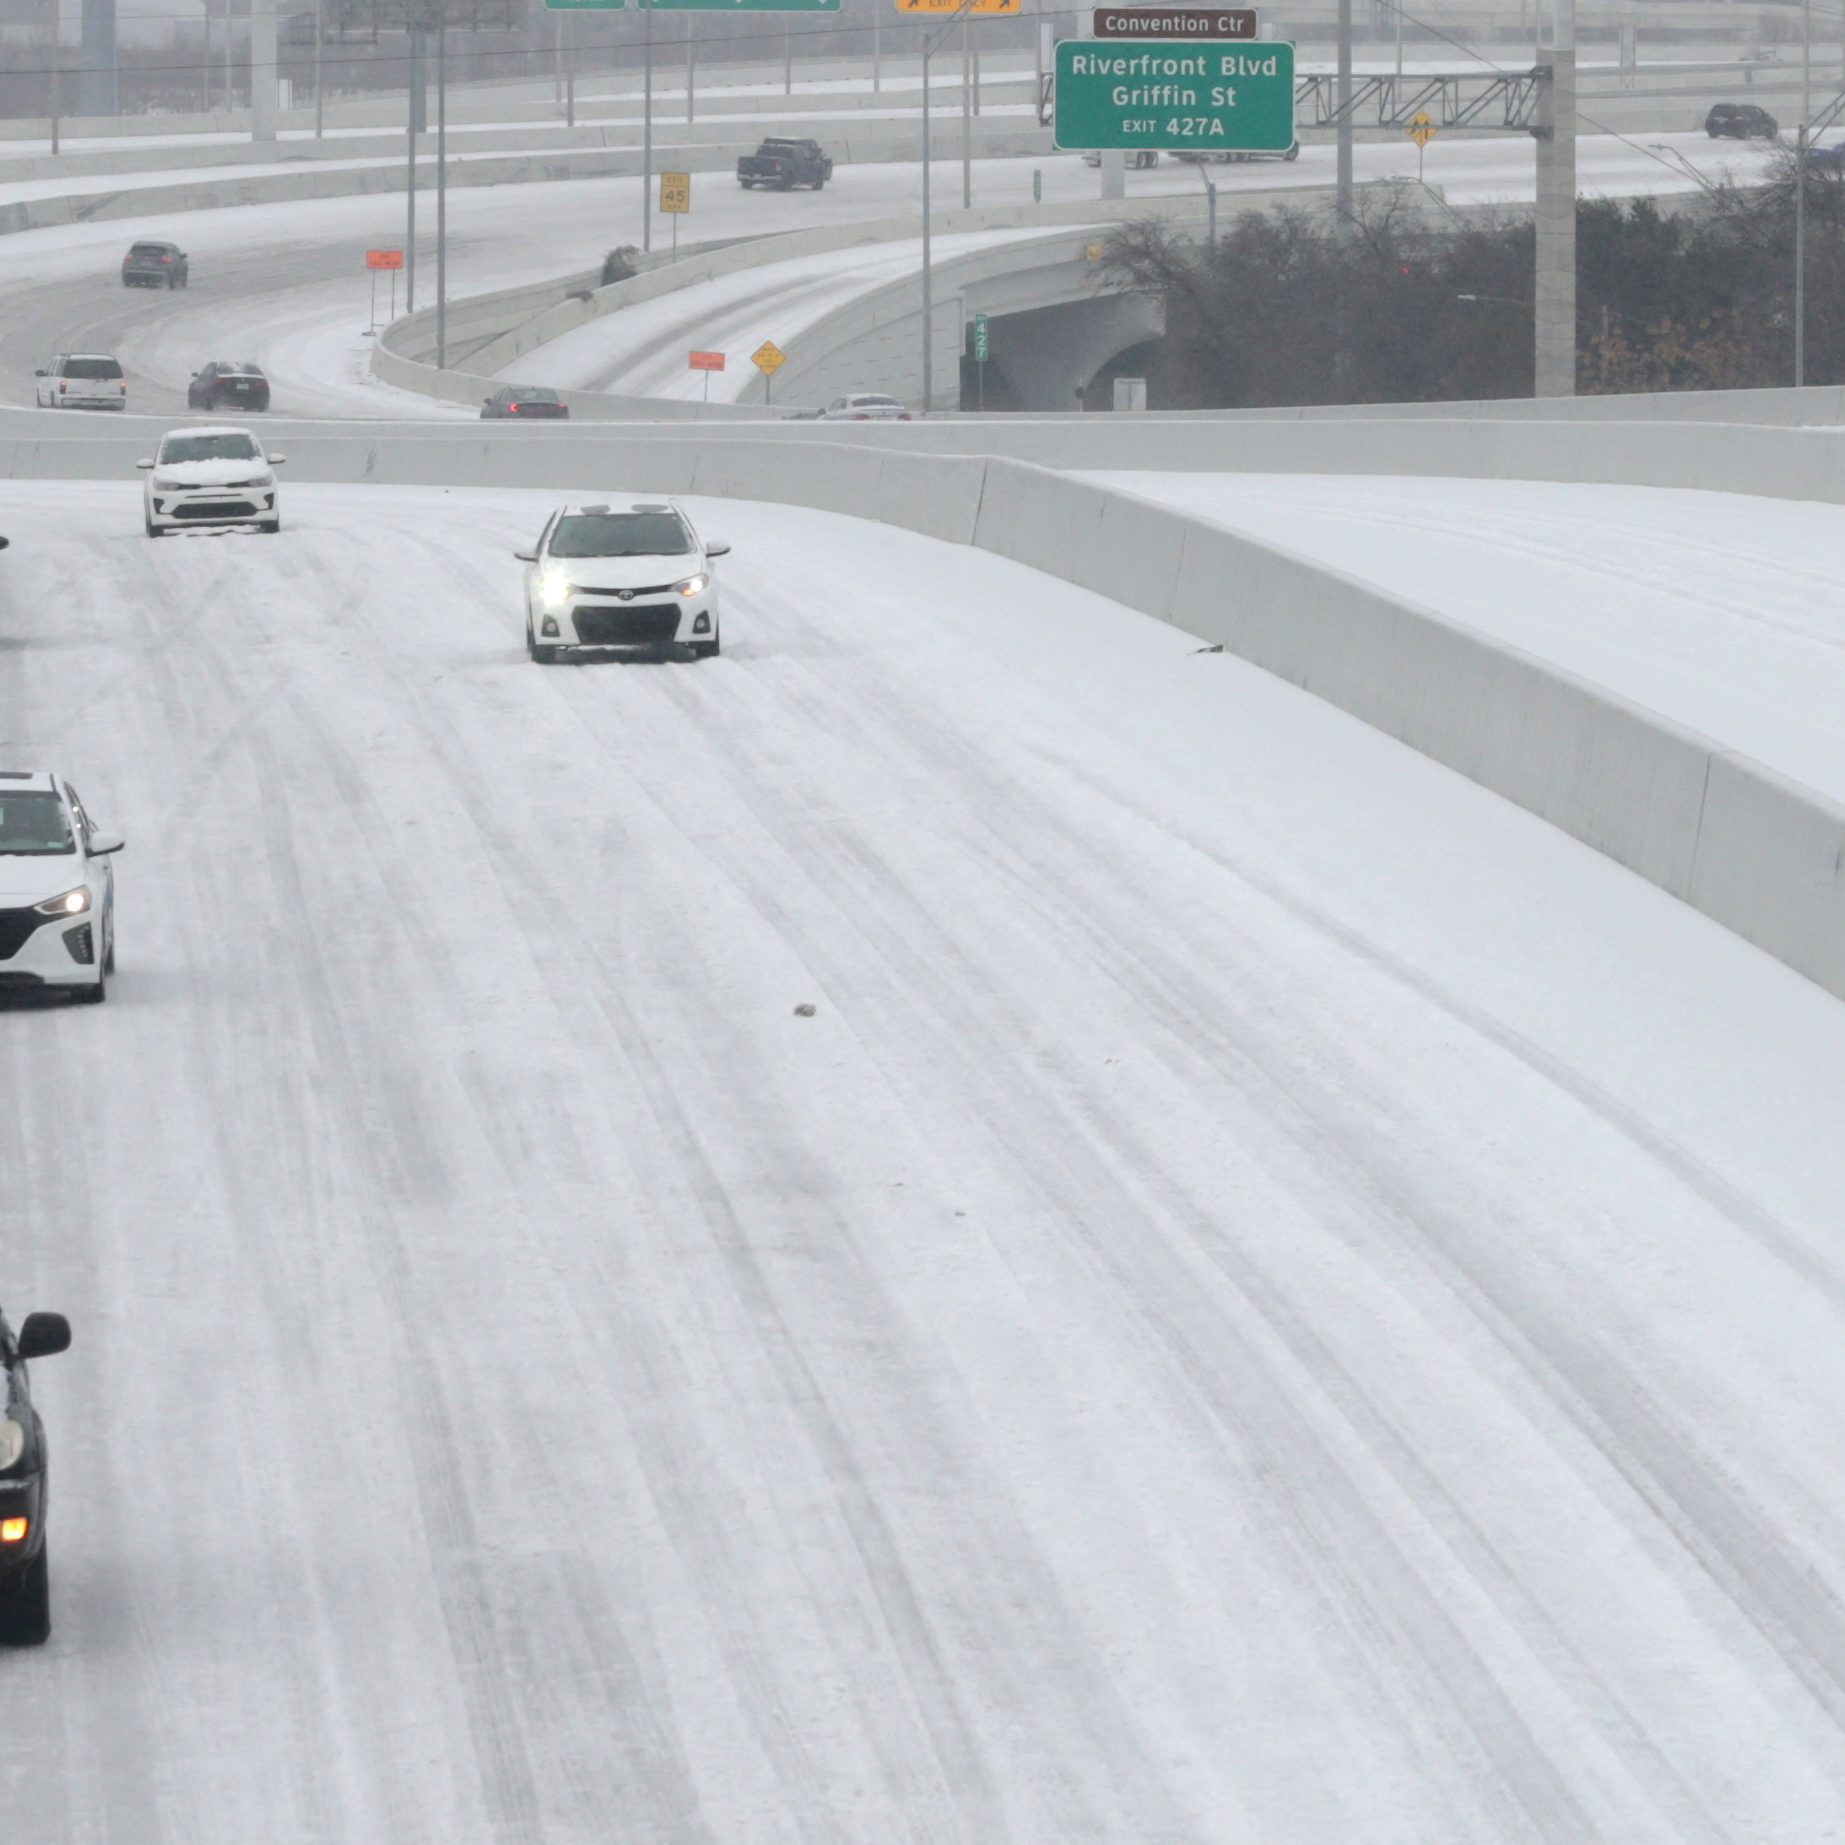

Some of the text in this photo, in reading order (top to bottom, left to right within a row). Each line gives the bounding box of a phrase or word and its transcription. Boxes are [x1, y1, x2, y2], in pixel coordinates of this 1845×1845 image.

[1105, 15, 1244, 32] Convention Ctr
[1072, 54, 1277, 76] Riverfront Blvd
[1112, 85, 1237, 107] Griffin St
[1122, 118, 1225, 136] EXIT 427A
[665, 190, 685, 202] 45
[976, 322, 986, 358] 427
